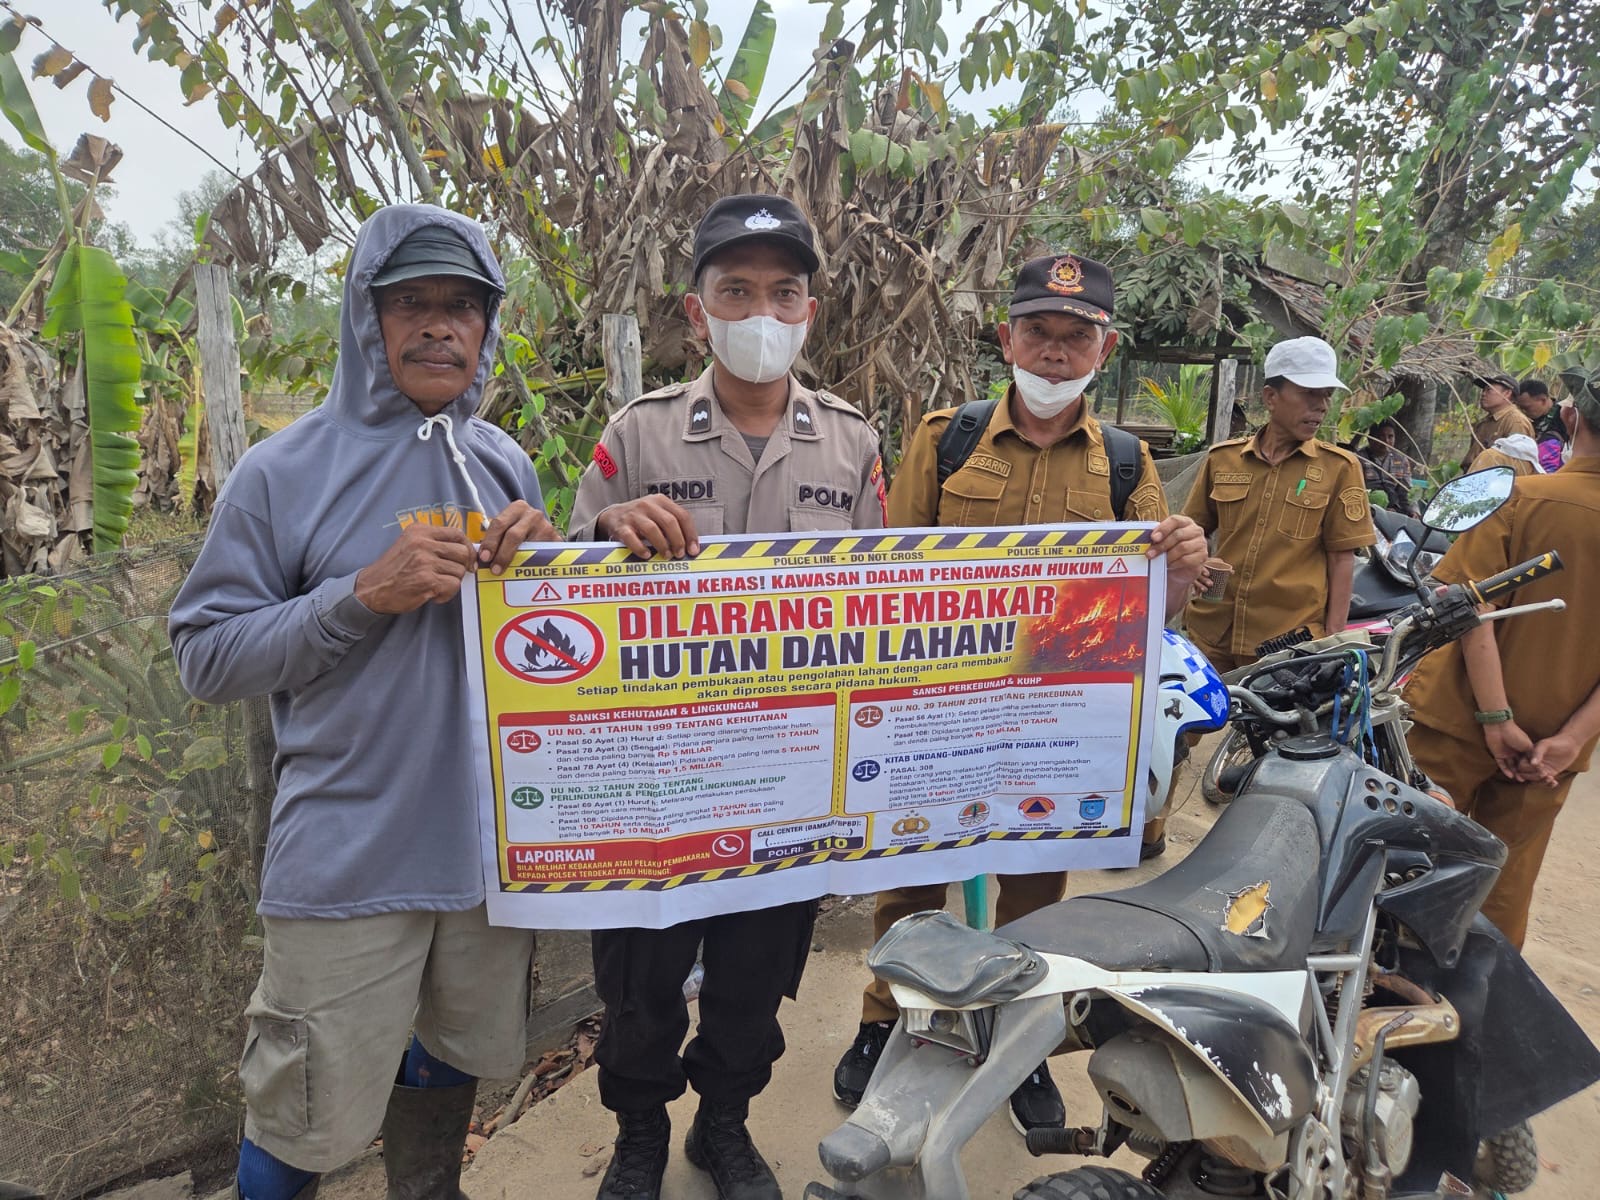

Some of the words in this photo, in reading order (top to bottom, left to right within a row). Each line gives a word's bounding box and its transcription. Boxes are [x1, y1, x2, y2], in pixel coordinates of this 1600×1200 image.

[773, 555, 811, 566] POLICE
[813, 555, 837, 565] LINE
[850, 554, 865, 563] DO
[867, 553, 888, 562] NOT
[891, 551, 924, 561] CROSS
[1007, 547, 1041, 557] POLICE
[1043, 547, 1064, 556] LINE
[1076, 546, 1088, 555] DO
[1091, 545, 1110, 554] NOT
[1112, 545, 1140, 554] CROSS
[515, 568, 559, 578] POLICE
[562, 567, 589, 576] LINE
[606, 565, 622, 574] DO
[626, 563, 649, 573] NOT
[652, 562, 689, 572] CROSS
[567, 577, 691, 599] PERINGATAN
[697, 576, 765, 594] KERAS!
[771, 571, 859, 589] KAWASAN
[866, 568, 924, 584] DALAM
[930, 564, 1043, 582] PENGAWASAN
[1048, 562, 1103, 576] HUKUM
[618, 596, 833, 641] DILARANG
[845, 585, 1056, 628] MEMBAKAR
[619, 636, 768, 681] HUTAN
[782, 631, 865, 669] DAN
[878, 620, 1017, 663] LAHAN!
[577, 686, 618, 697] Setiap
[622, 682, 678, 693] tindakan
[682, 676, 753, 691] pembukaan
[758, 674, 784, 682] atau
[788, 669, 854, 682] pengolahan
[858, 667, 889, 676] lahan
[893, 663, 933, 674] dengan
[936, 662, 958, 670] cara
[961, 655, 1012, 667] membakar
[697, 689, 728, 699] akan
[733, 685, 787, 697] diproses
[791, 682, 832, 692] secara
[835, 677, 875, 690] pidana
[879, 676, 921, 686] hukum.
[912, 687, 946, 696] SANKSI
[948, 679, 1006, 693] PERKEBUNAN
[1007, 677, 1014, 685] &
[1017, 677, 1042, 685] KUHP
[968, 697, 987, 705] 2014
[990, 692, 1025, 703] TENTANG
[1028, 690, 1083, 699] PERKEBUNAN
[569, 712, 610, 722] SANKSI
[613, 707, 677, 719] KEHUTANAN
[680, 707, 689, 715] &
[691, 701, 759, 715] LINGKUNGAN
[547, 729, 563, 737] UU
[567, 728, 586, 736] NO.
[589, 727, 602, 735] 41
[606, 725, 643, 734] TAHUN
[646, 723, 673, 732] 1999
[676, 718, 723, 730] TENTANG
[726, 712, 788, 725] KEHUTANAN
[555, 739, 579, 747] Pasal
[595, 737, 615, 746] Ayat
[556, 747, 579, 755] Pasal
[595, 746, 615, 754] Ayat
[789, 729, 819, 738] TAHUN
[556, 764, 581, 772] Pasal
[597, 762, 616, 771] Ayat
[790, 744, 820, 753] TAHUN
[601, 752, 626, 762] paling
[628, 751, 655, 760] banyak
[885, 756, 910, 764] KITAB
[913, 745, 984, 761] UNDANG-UNDANG
[1015, 741, 1046, 749] PIDANA
[1049, 740, 1079, 749] (KUHP)
[574, 771, 600, 779] denda
[602, 770, 627, 779] paling
[628, 768, 655, 777] banyak
[550, 791, 623, 802] PERLINDUNGAN
[635, 785, 698, 798] PENGELOLAAN
[700, 779, 757, 791] LINGKUNGAN
[759, 776, 786, 785] HIDUP
[568, 786, 585, 794] NO.
[588, 785, 600, 793] 32
[602, 783, 636, 792] TAHUN
[638, 782, 660, 791] 2009
[662, 777, 704, 788] TENTANG
[719, 803, 747, 811] TAHUN
[592, 821, 621, 829] TAHUN
[757, 829, 774, 838] CALL
[777, 824, 803, 835] CENTER
[515, 848, 595, 864] LAPORKAN
[768, 846, 804, 858] POLRI:
[811, 837, 848, 851] 110
[535, 863, 566, 871] MELIHAT
[568, 861, 613, 870] KEBAKARAN
[635, 860, 662, 868] PELAKU
[663, 852, 711, 866] PEMBAKARAN
[548, 871, 577, 879] POLSEK
[579, 869, 616, 878] TERDEKAT
[619, 868, 636, 876] ATAU
